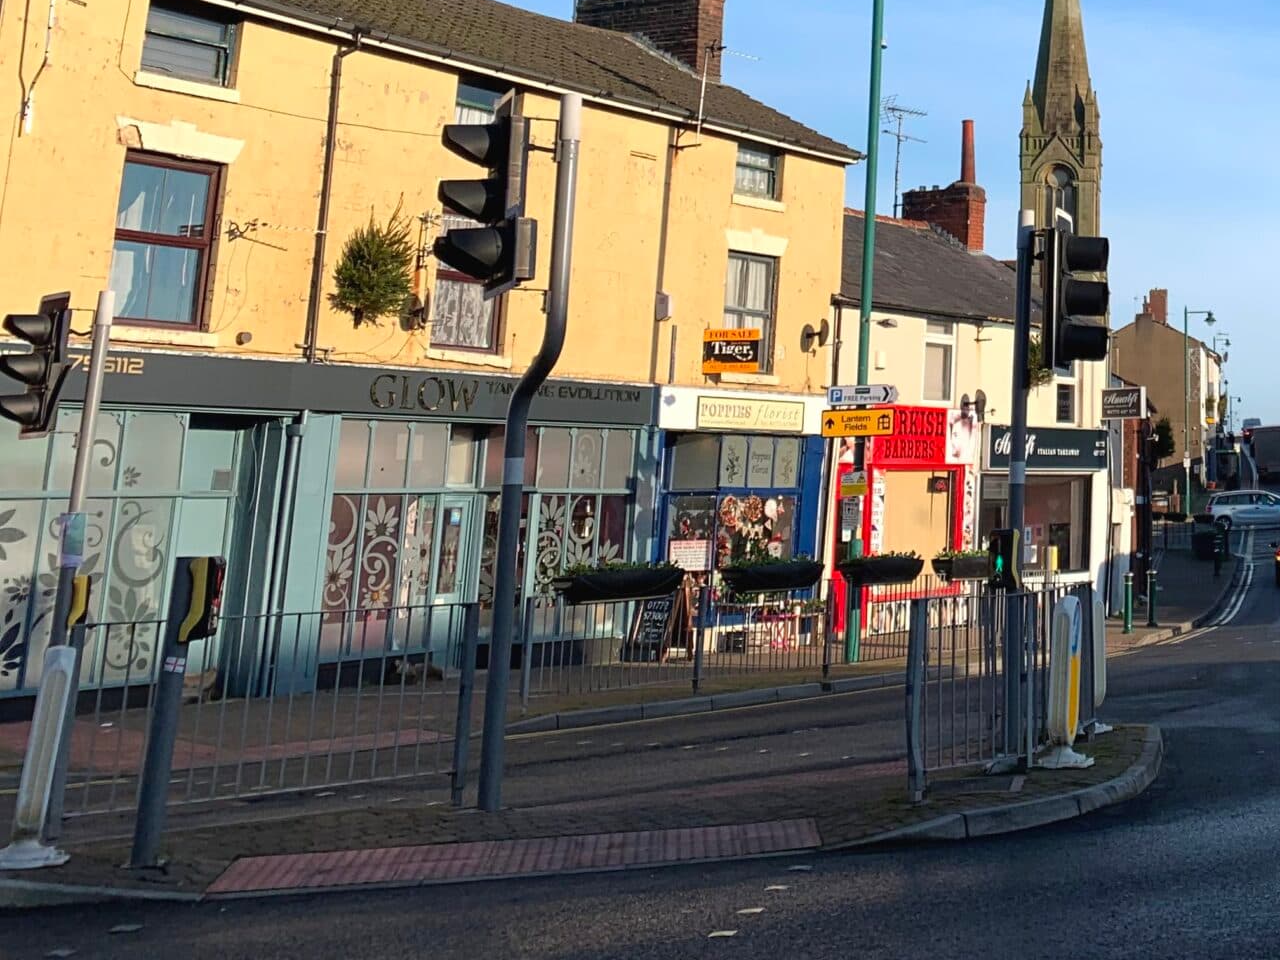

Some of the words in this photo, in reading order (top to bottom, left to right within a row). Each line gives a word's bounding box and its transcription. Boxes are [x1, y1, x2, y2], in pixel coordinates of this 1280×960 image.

[711, 341, 752, 356] Tiger
[369, 373, 478, 413] GLOW
[486, 380, 554, 398] TANG
[558, 385, 641, 404] EVOLUTION
[701, 403, 752, 419] POPPIES
[754, 404, 800, 426] florist
[841, 415, 871, 423] Lantern
[897, 410, 945, 437] RKISH
[884, 439, 935, 459] BARBERS
[994, 432, 1037, 461] Afi
